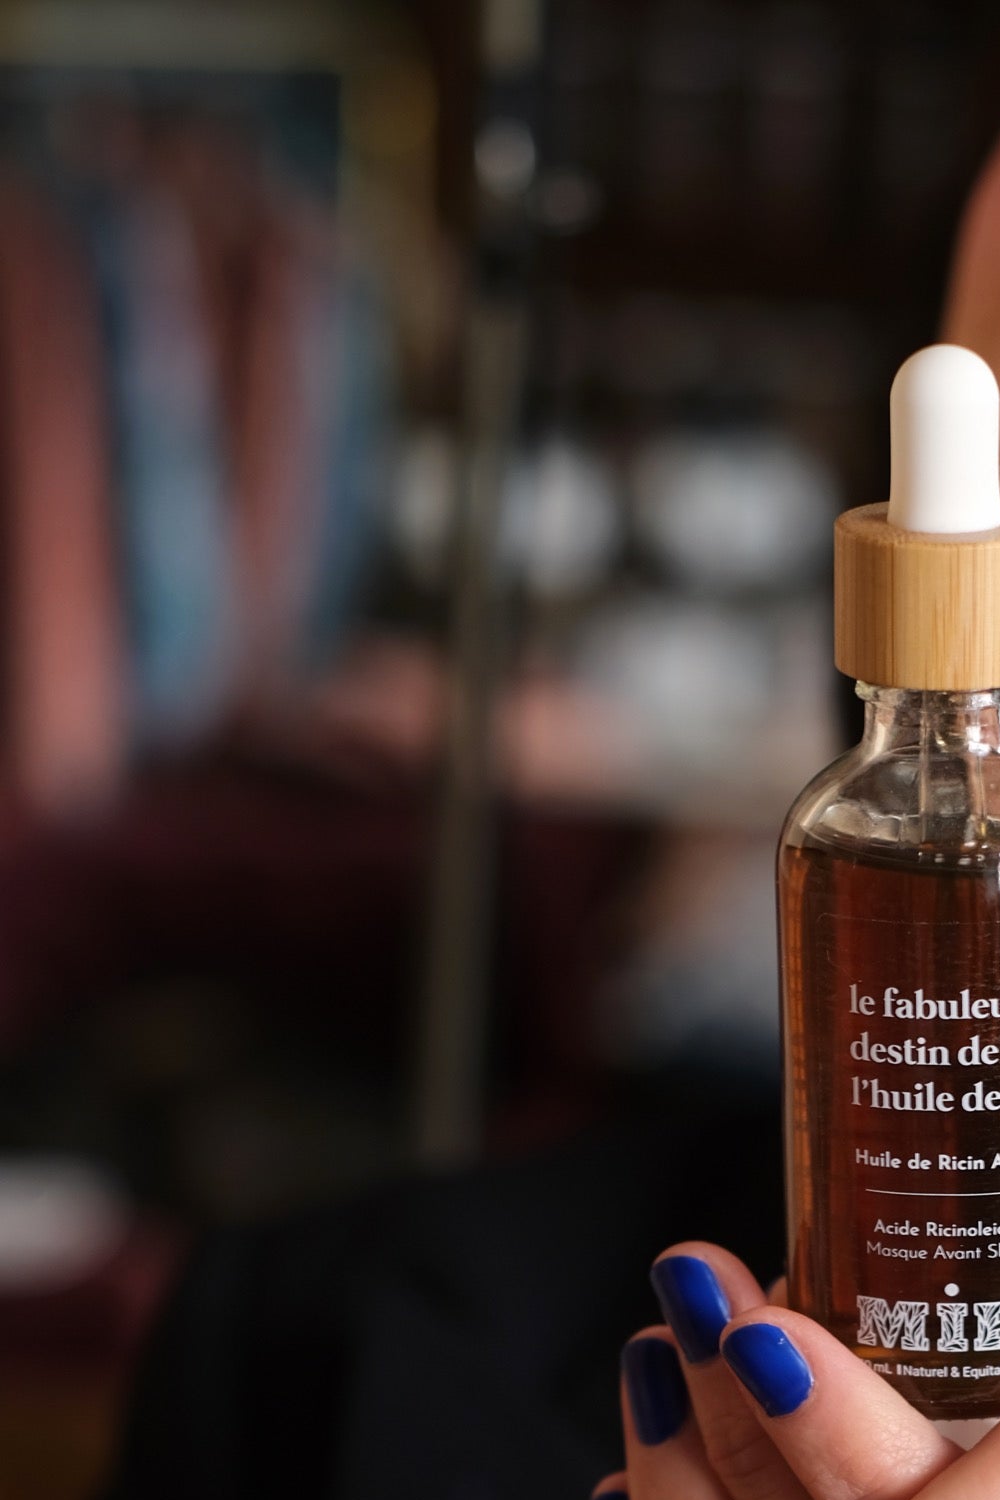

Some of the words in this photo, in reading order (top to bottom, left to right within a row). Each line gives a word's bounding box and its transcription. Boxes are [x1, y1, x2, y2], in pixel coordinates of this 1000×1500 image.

[849, 983, 875, 1015] le
[850, 1031, 951, 1066] destin
[957, 1035, 999, 1066] de
[851, 1076, 954, 1112] l’huile
[855, 1148, 901, 1169] Huile
[907, 1153, 932, 1170] de
[938, 1154, 985, 1170] Ricin
[873, 1219, 920, 1237] Acide
[866, 1240, 927, 1261] Masque
[933, 1244, 982, 1260] Avant
[903, 1364, 948, 1378] Naturel
[950, 1366, 960, 1378] &
